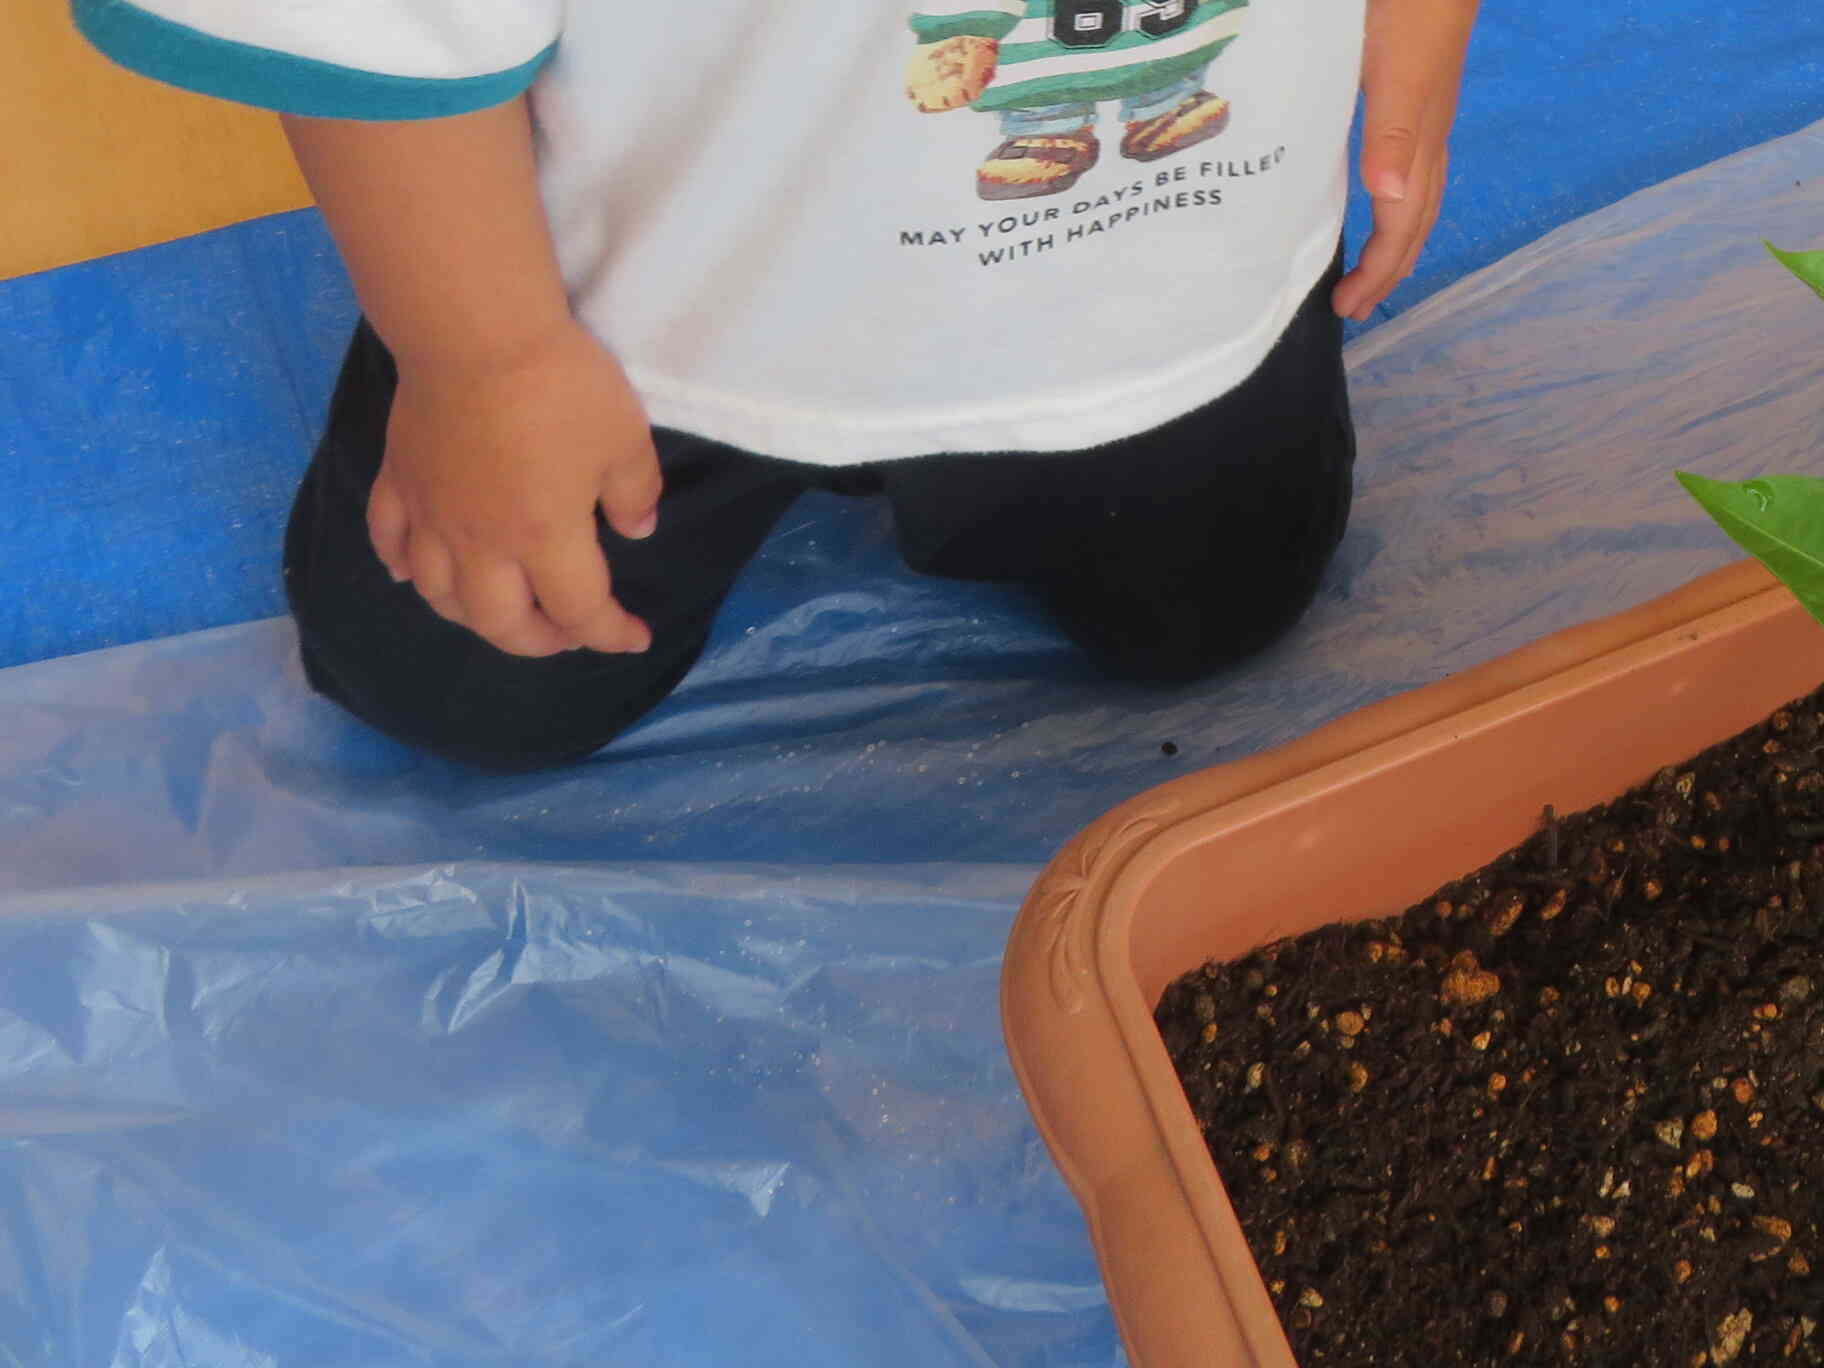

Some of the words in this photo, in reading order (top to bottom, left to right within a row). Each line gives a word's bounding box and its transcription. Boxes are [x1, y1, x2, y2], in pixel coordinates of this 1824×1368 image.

[899, 226, 966, 246] MAY
[978, 207, 1060, 237] YOUR
[1071, 180, 1144, 214] DAYS
[1154, 166, 1188, 187] BE
[978, 234, 1055, 266] WITH
[1066, 188, 1223, 243] HAPPINESS
